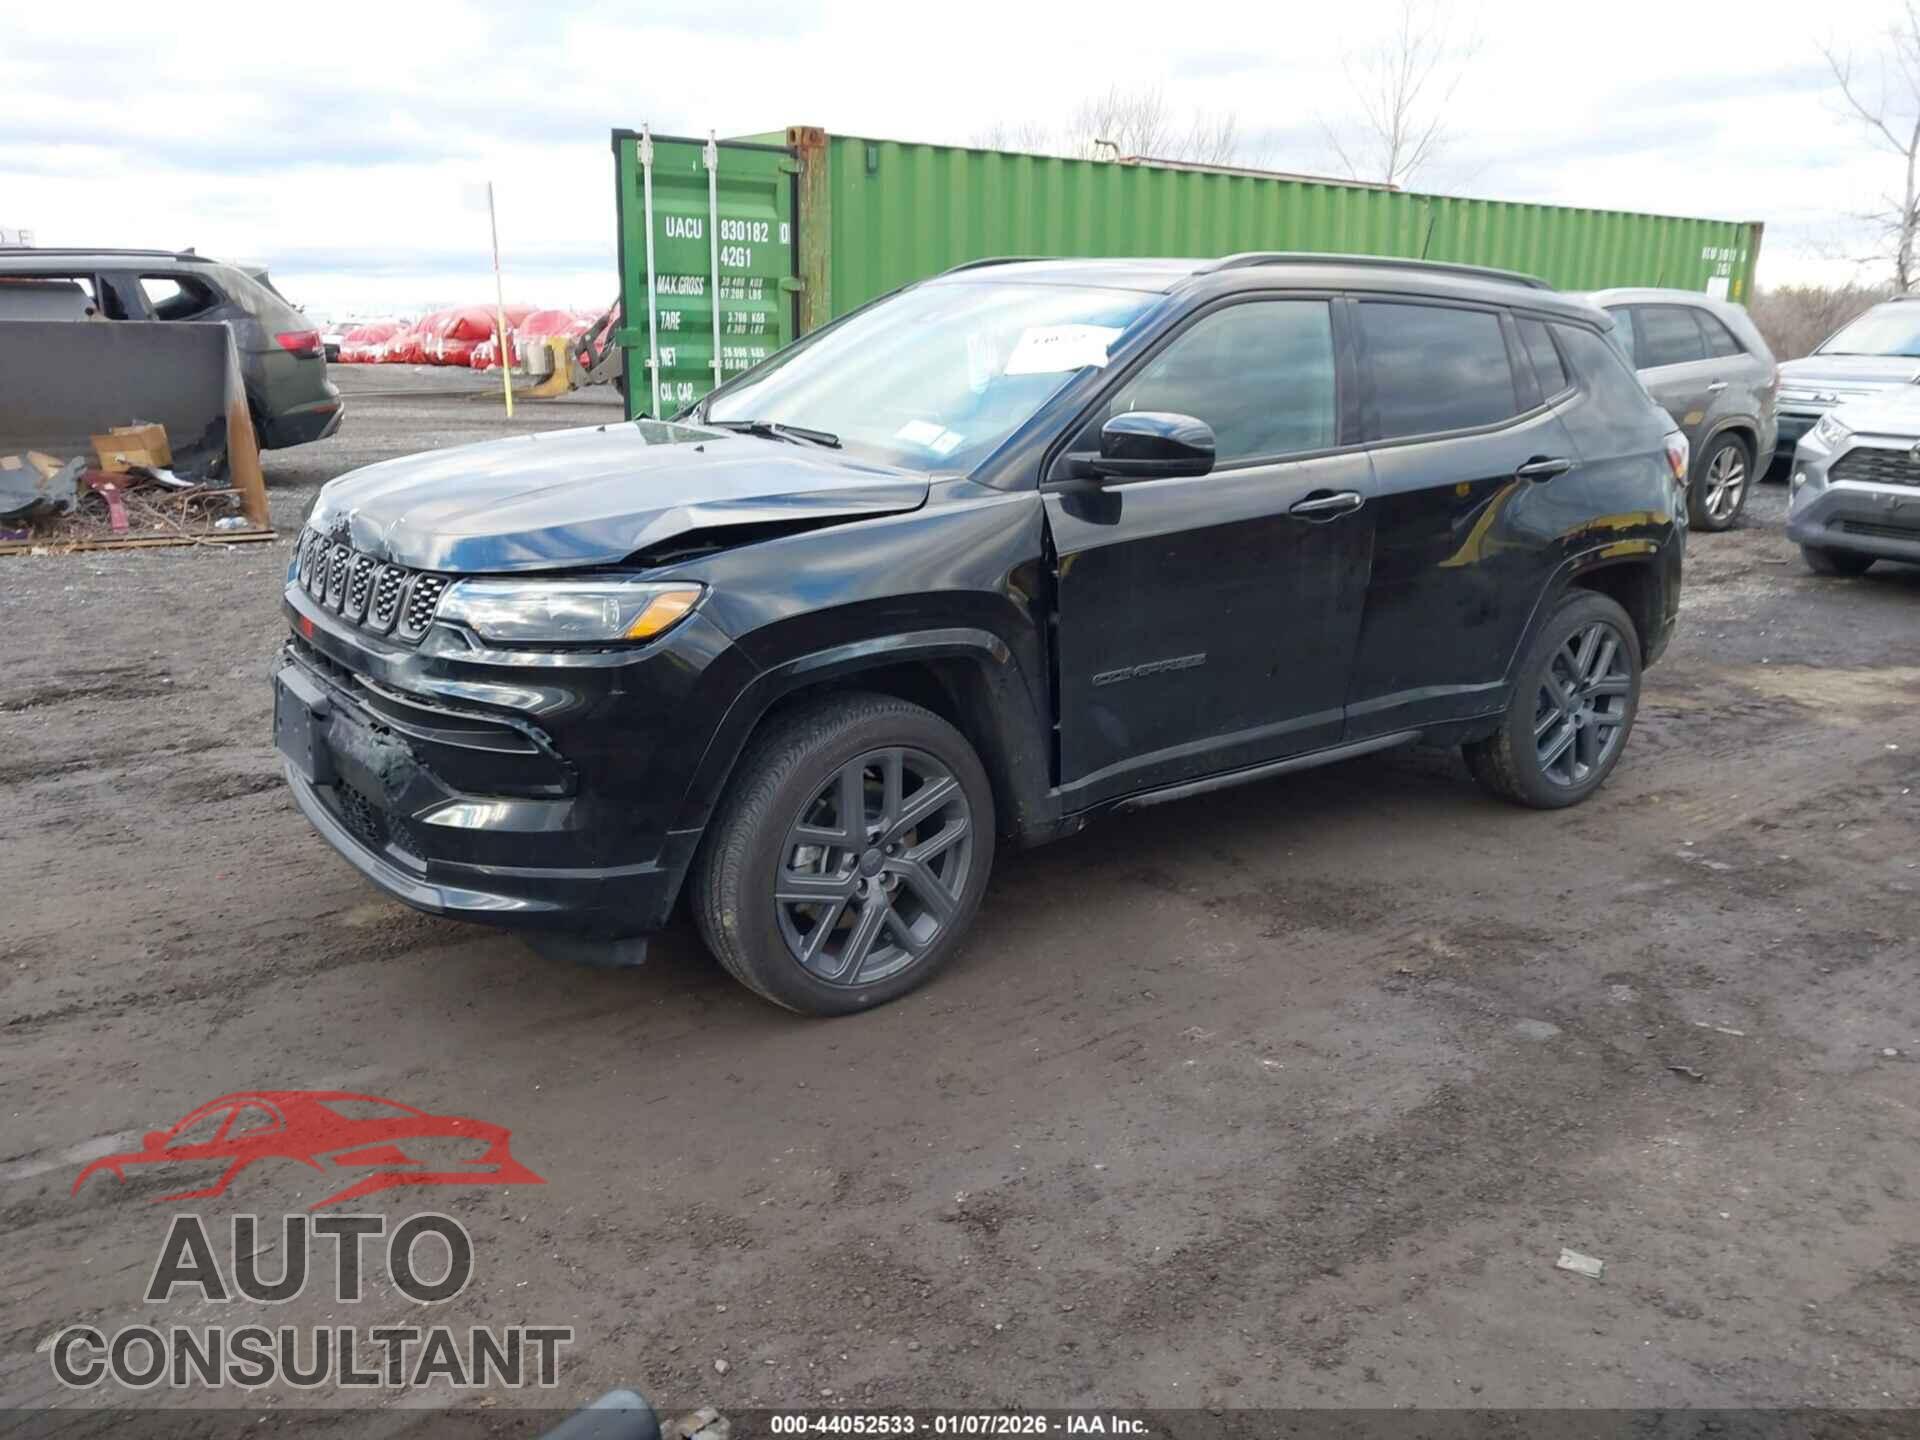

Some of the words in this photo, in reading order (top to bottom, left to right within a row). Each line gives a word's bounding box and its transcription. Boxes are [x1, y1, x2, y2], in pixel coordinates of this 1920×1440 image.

[665, 216, 702, 239] UACU
[720, 219, 769, 243] 830182
[779, 222, 789, 244] 0
[719, 245, 751, 268] 42G1
[660, 311, 681, 330] TARE
[660, 347, 676, 367] NET
